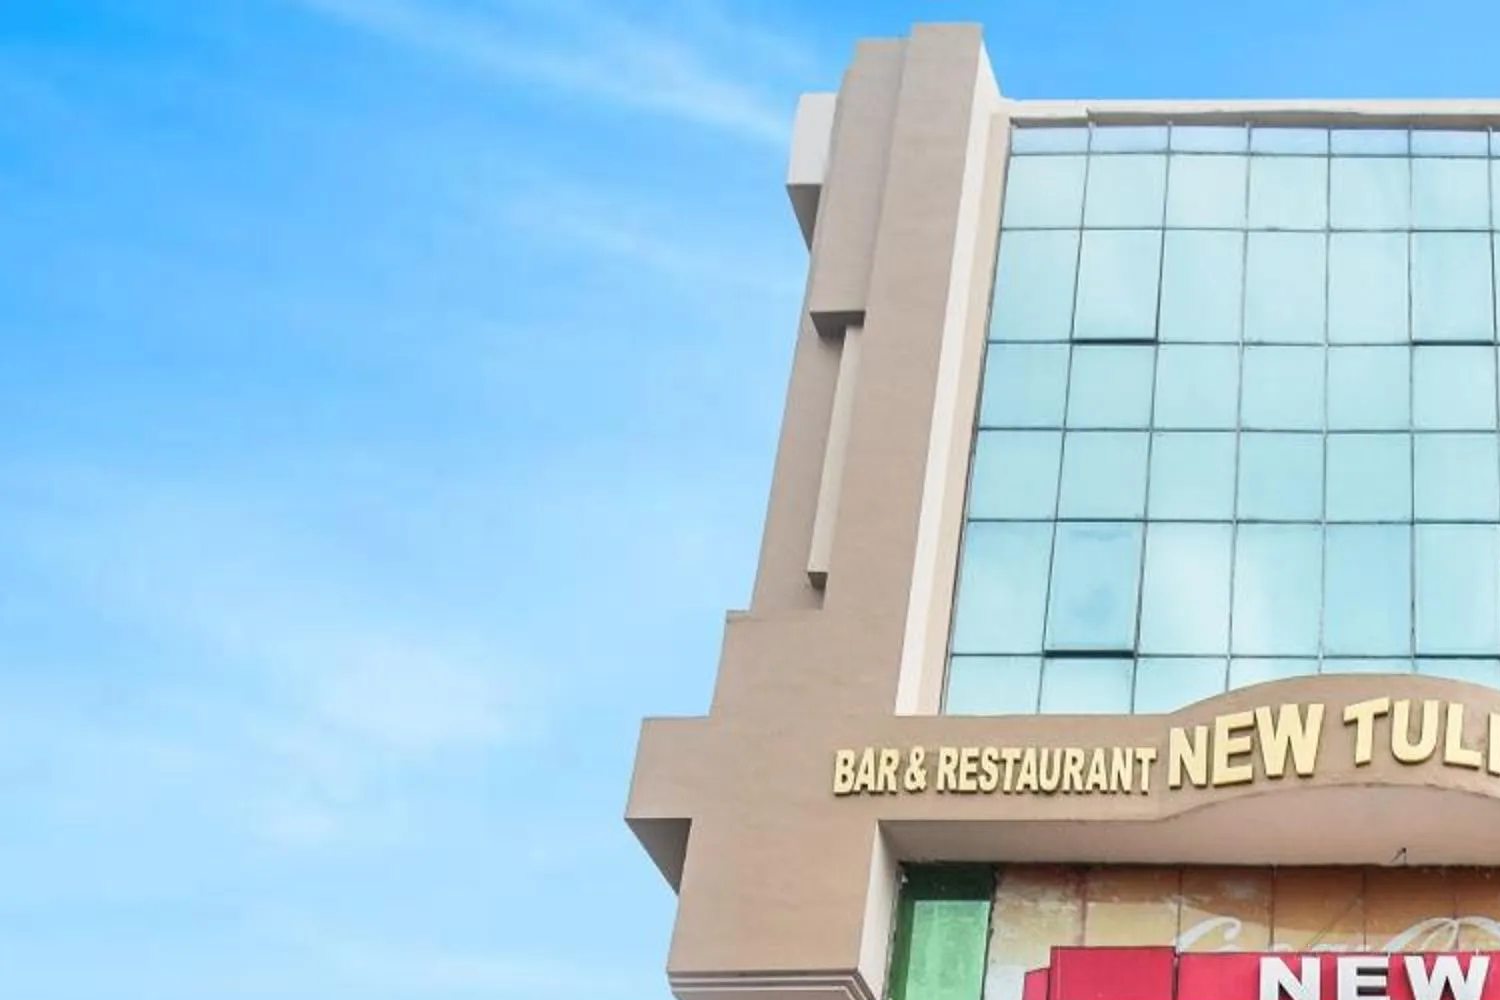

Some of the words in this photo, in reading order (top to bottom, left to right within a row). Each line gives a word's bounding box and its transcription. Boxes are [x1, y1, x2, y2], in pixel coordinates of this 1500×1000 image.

[833, 748, 900, 796] BAR
[904, 746, 927, 793] &
[936, 746, 1157, 795] RESTAURANT
[1168, 703, 1325, 790] NEW
